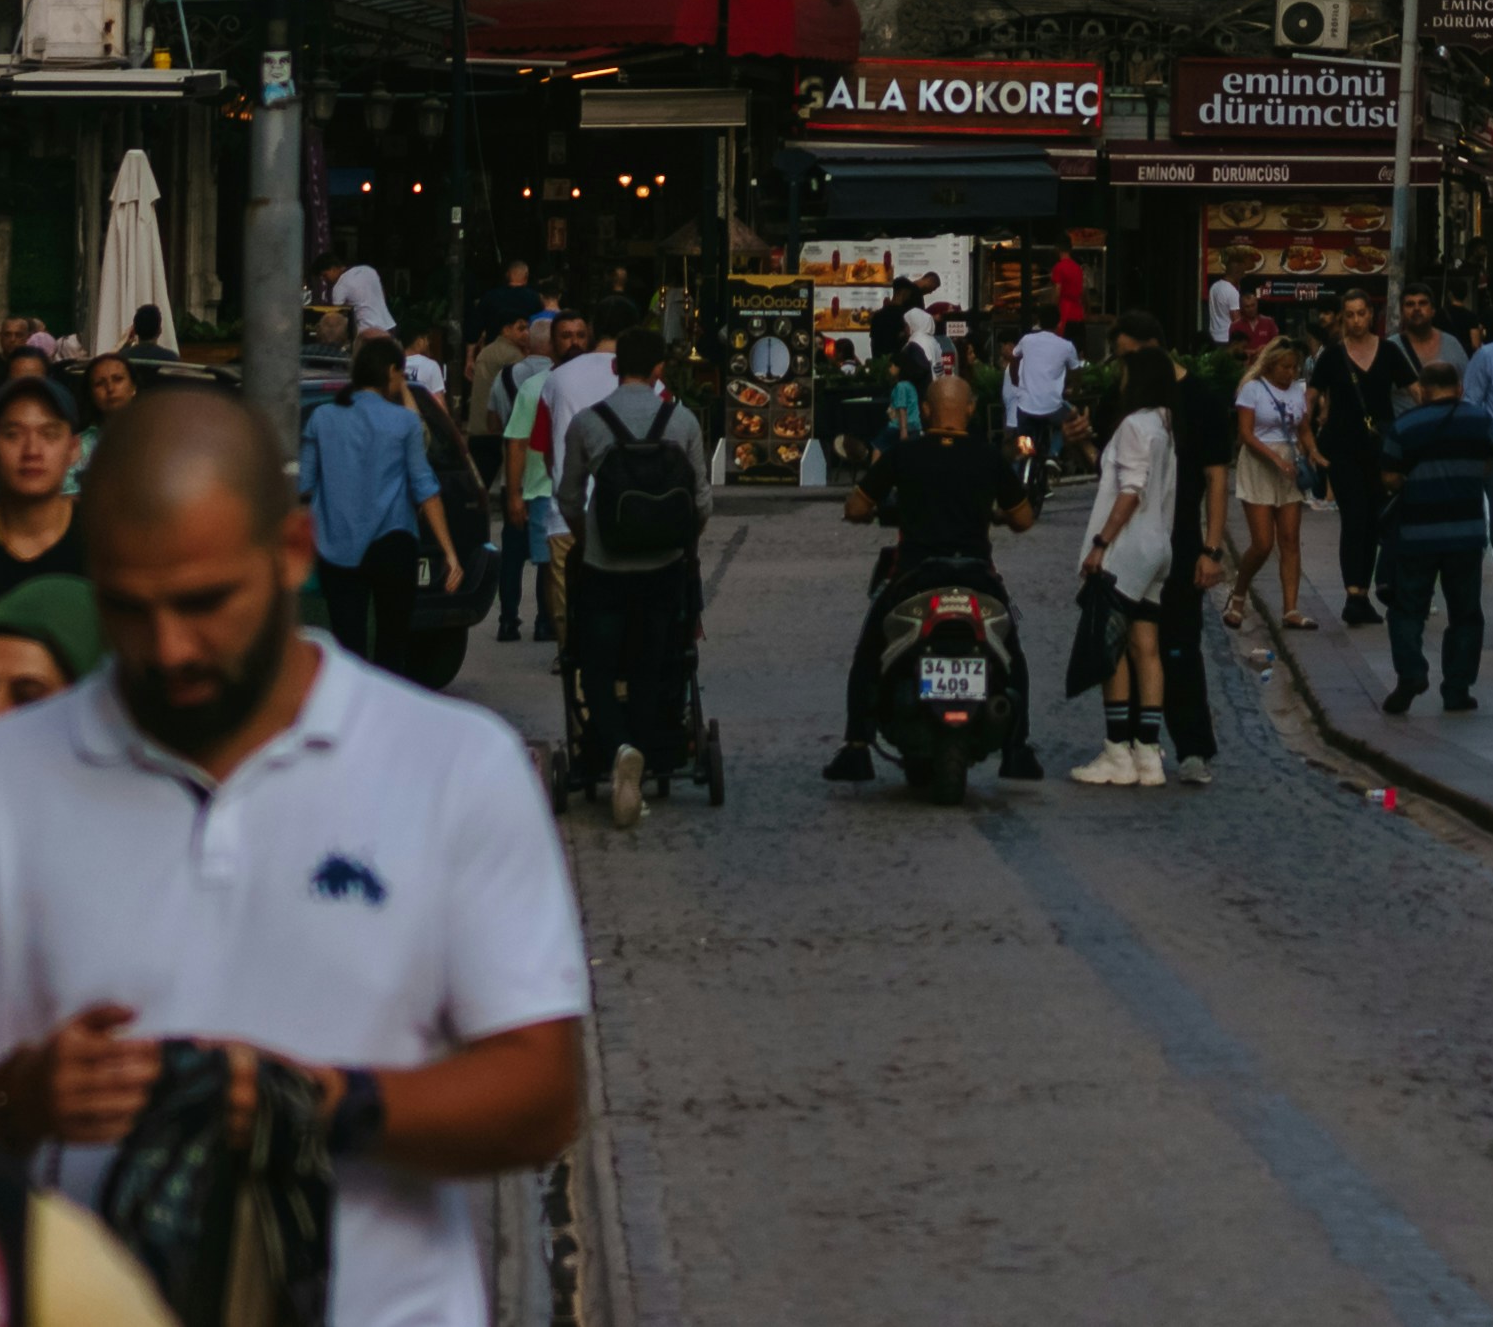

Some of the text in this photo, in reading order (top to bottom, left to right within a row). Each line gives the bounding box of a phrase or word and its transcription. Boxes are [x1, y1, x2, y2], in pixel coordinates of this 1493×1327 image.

[1222, 68, 1386, 97] eminönü
[918, 78, 1099, 125] KOKOREÇ
[924, 659, 984, 675] 34 DTZ
[936, 677, 969, 692] 409
